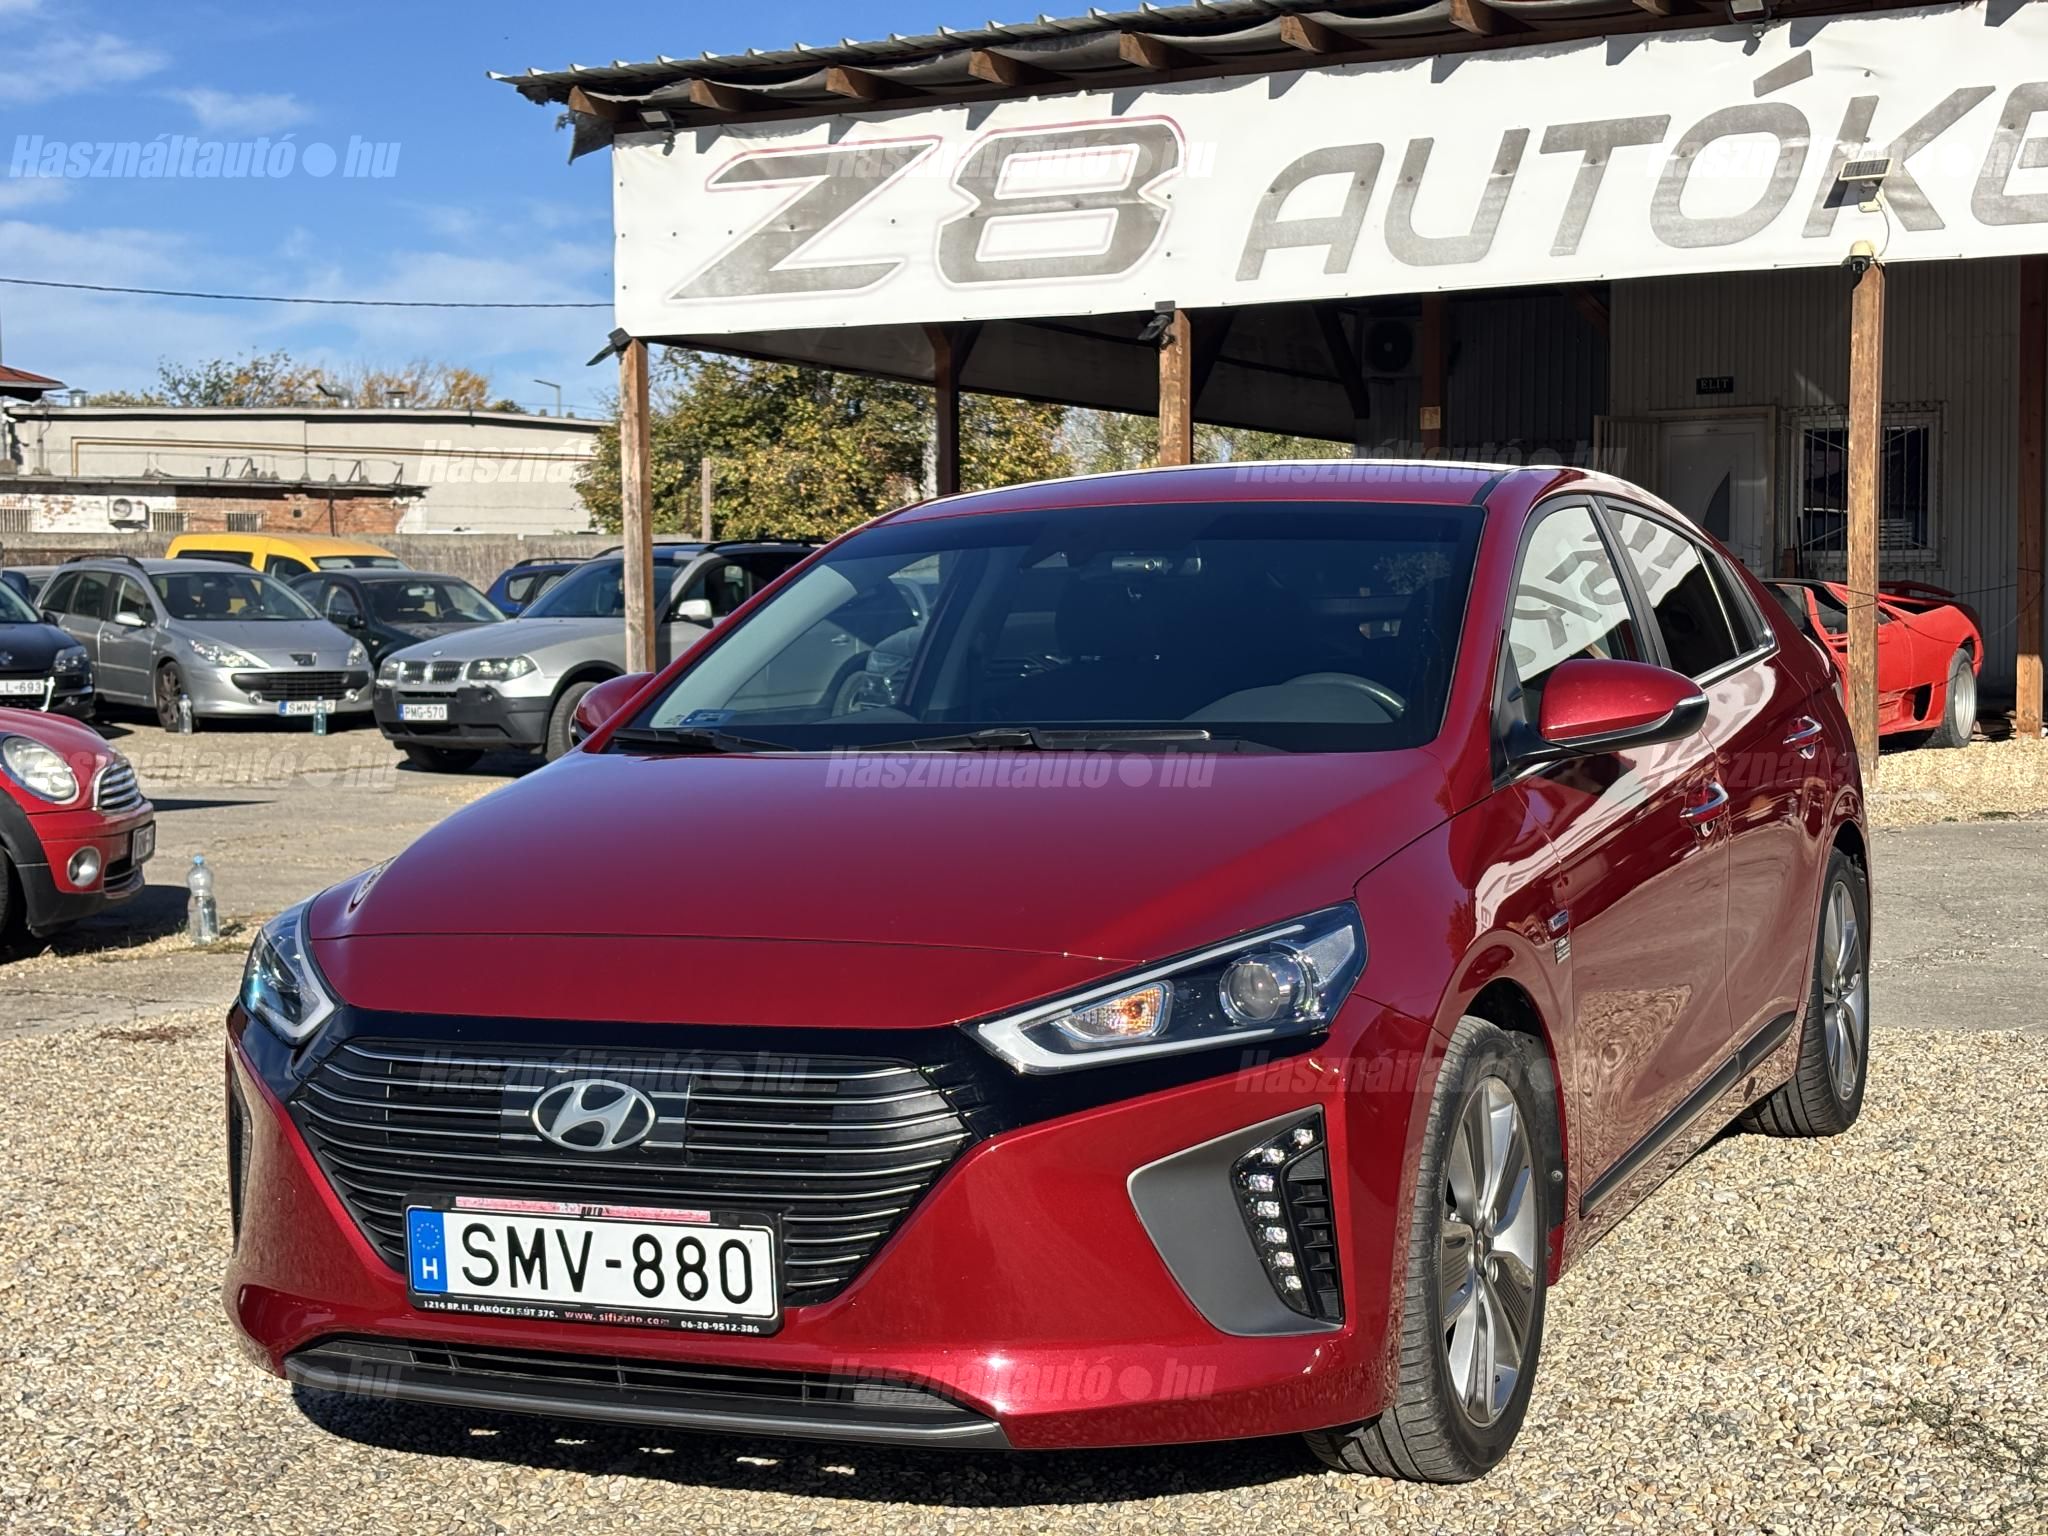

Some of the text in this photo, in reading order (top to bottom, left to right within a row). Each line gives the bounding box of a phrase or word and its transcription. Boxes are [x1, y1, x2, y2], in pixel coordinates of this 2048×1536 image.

[665, 113, 1187, 305] Z8
[1700, 379, 1729, 390] ELIT
[404, 706, 445, 718] PMG-570
[462, 1222, 753, 1305] SMV-880
[424, 1300, 445, 1309] 1214
